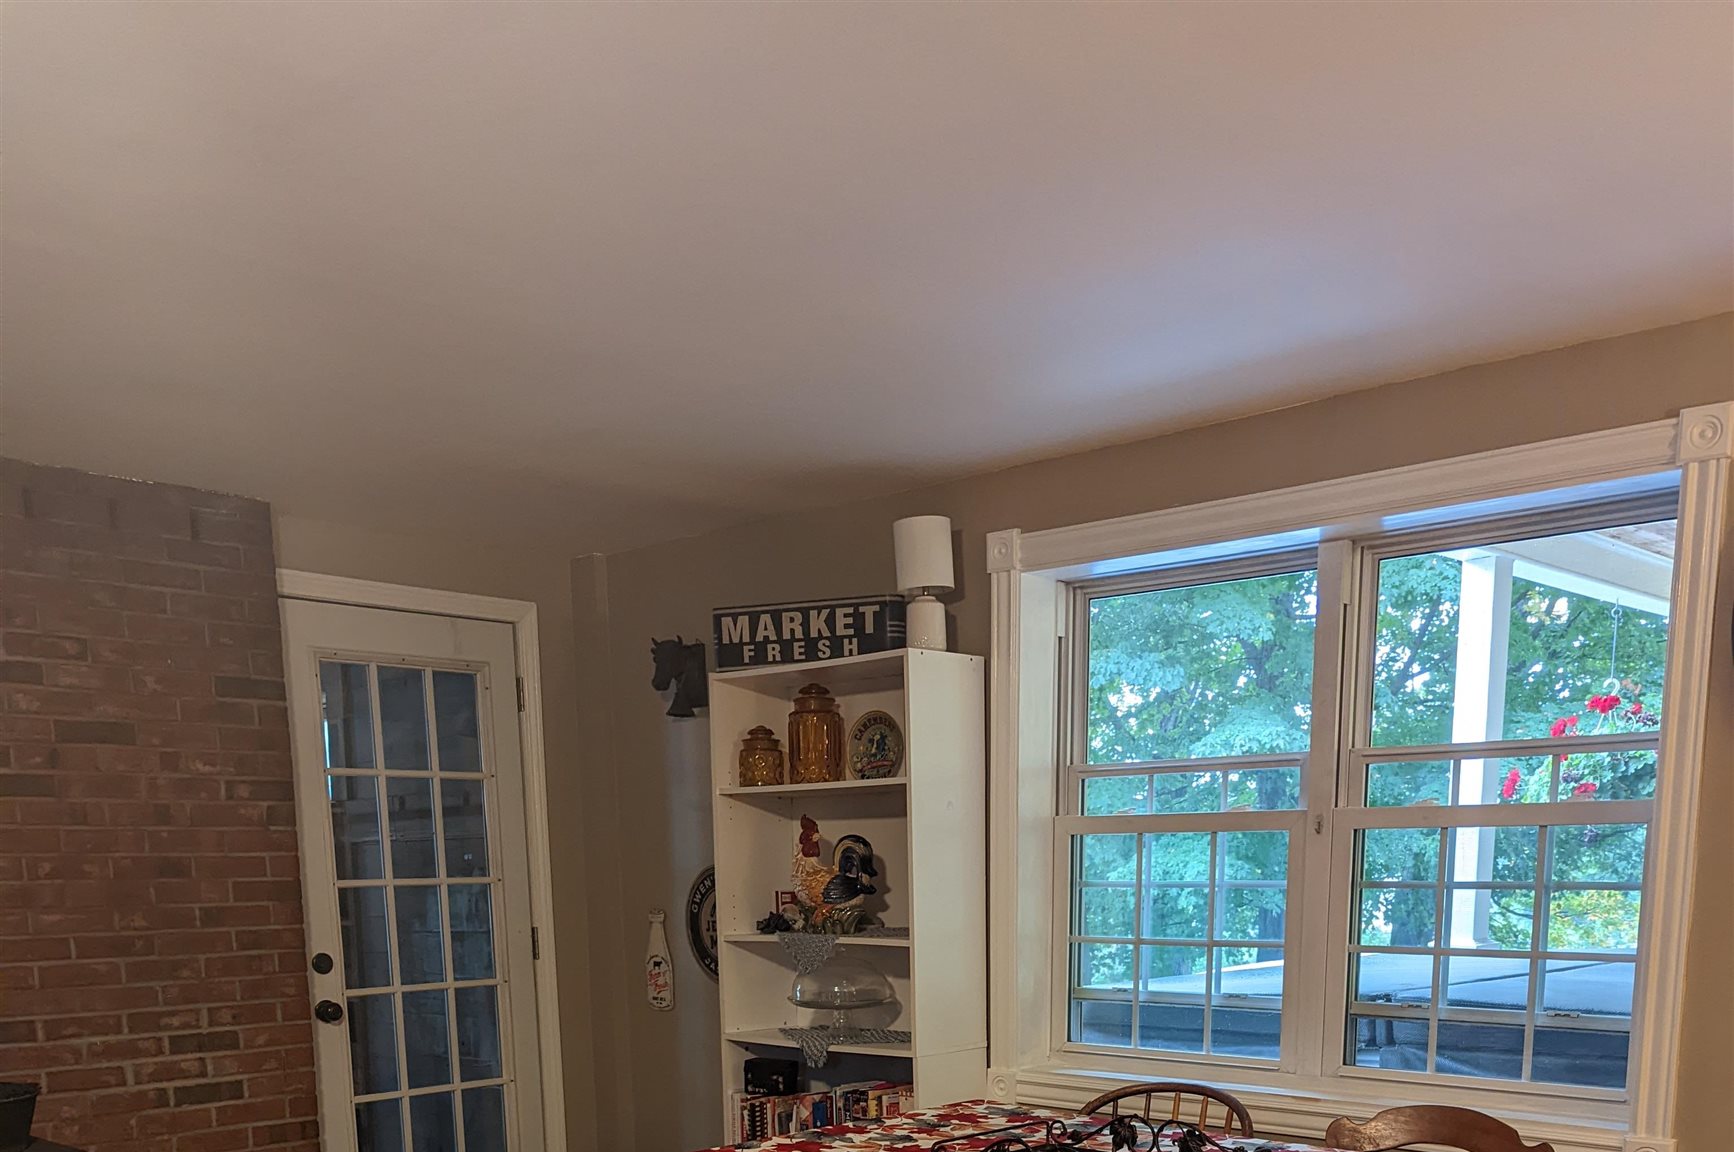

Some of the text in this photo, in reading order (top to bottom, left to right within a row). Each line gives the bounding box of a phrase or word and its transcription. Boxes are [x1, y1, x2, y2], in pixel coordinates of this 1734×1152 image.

[721, 605, 880, 644] MARKET
[743, 638, 858, 664] FRESH
[691, 876, 715, 913] GWEN'
